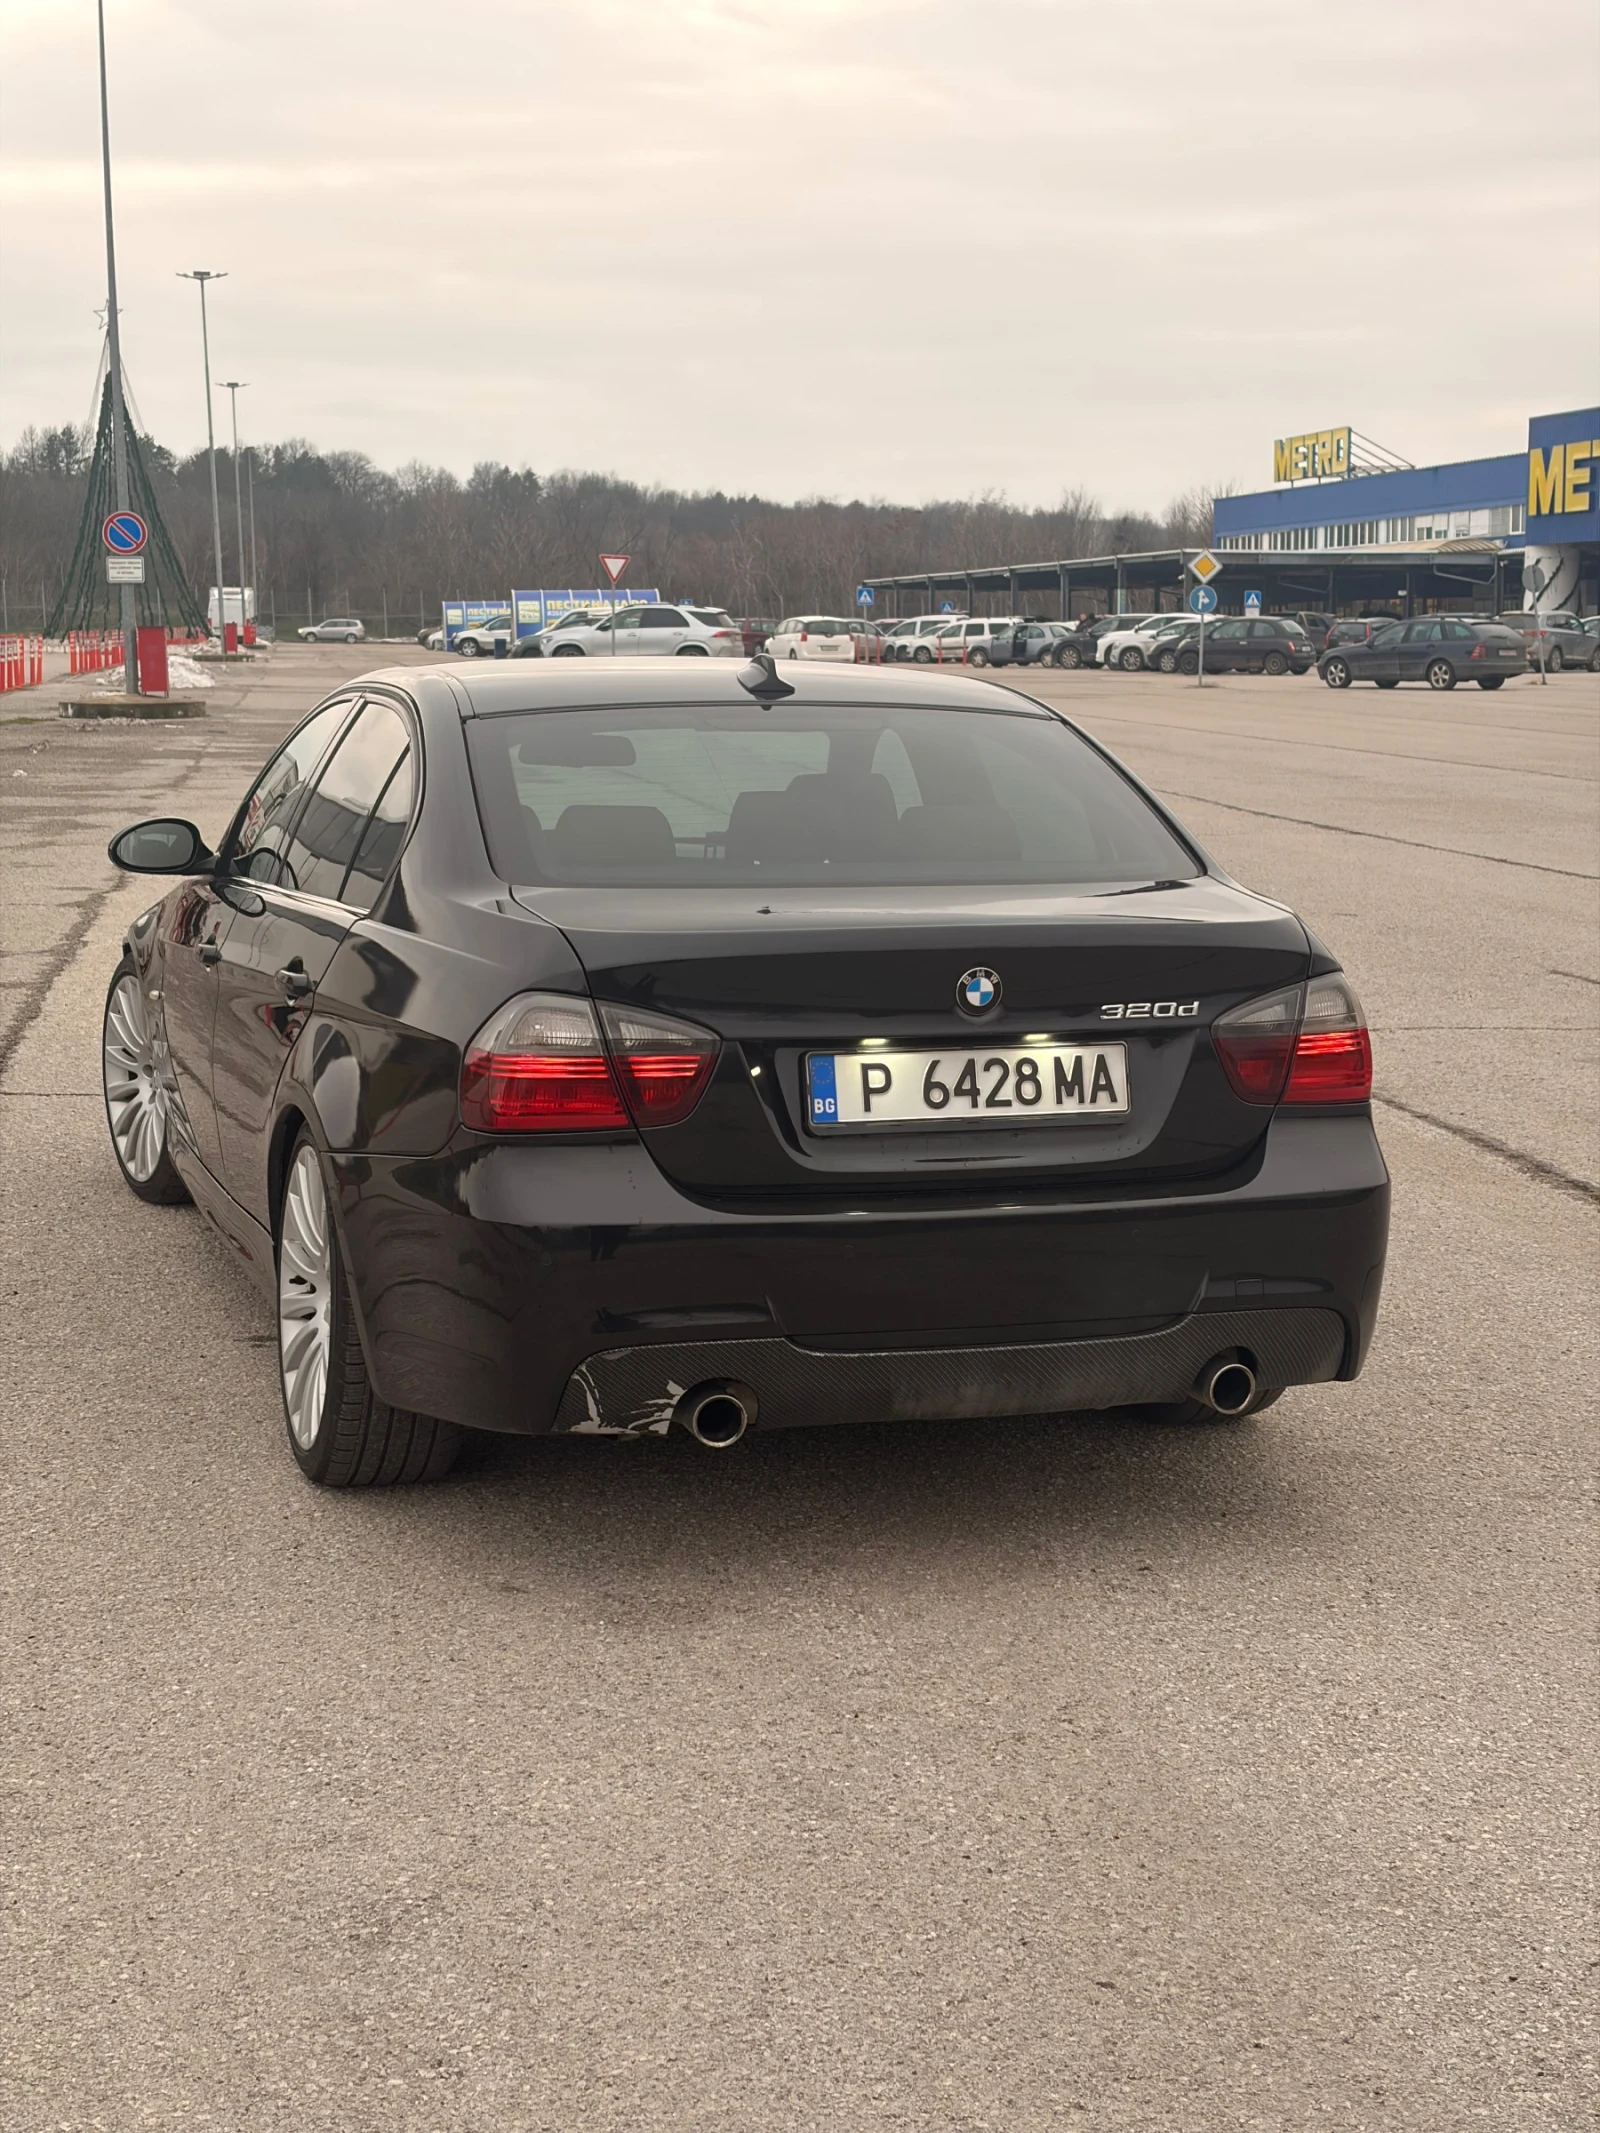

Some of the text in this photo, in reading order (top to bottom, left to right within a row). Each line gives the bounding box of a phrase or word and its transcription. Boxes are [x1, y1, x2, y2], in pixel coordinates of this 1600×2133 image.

[1274, 426, 1350, 483] METRO
[962, 969, 999, 985] BMW
[1100, 1001, 1199, 1019] 320d
[861, 1054, 1119, 1112] P 6428 MA
[814, 1098, 835, 1114] BG
